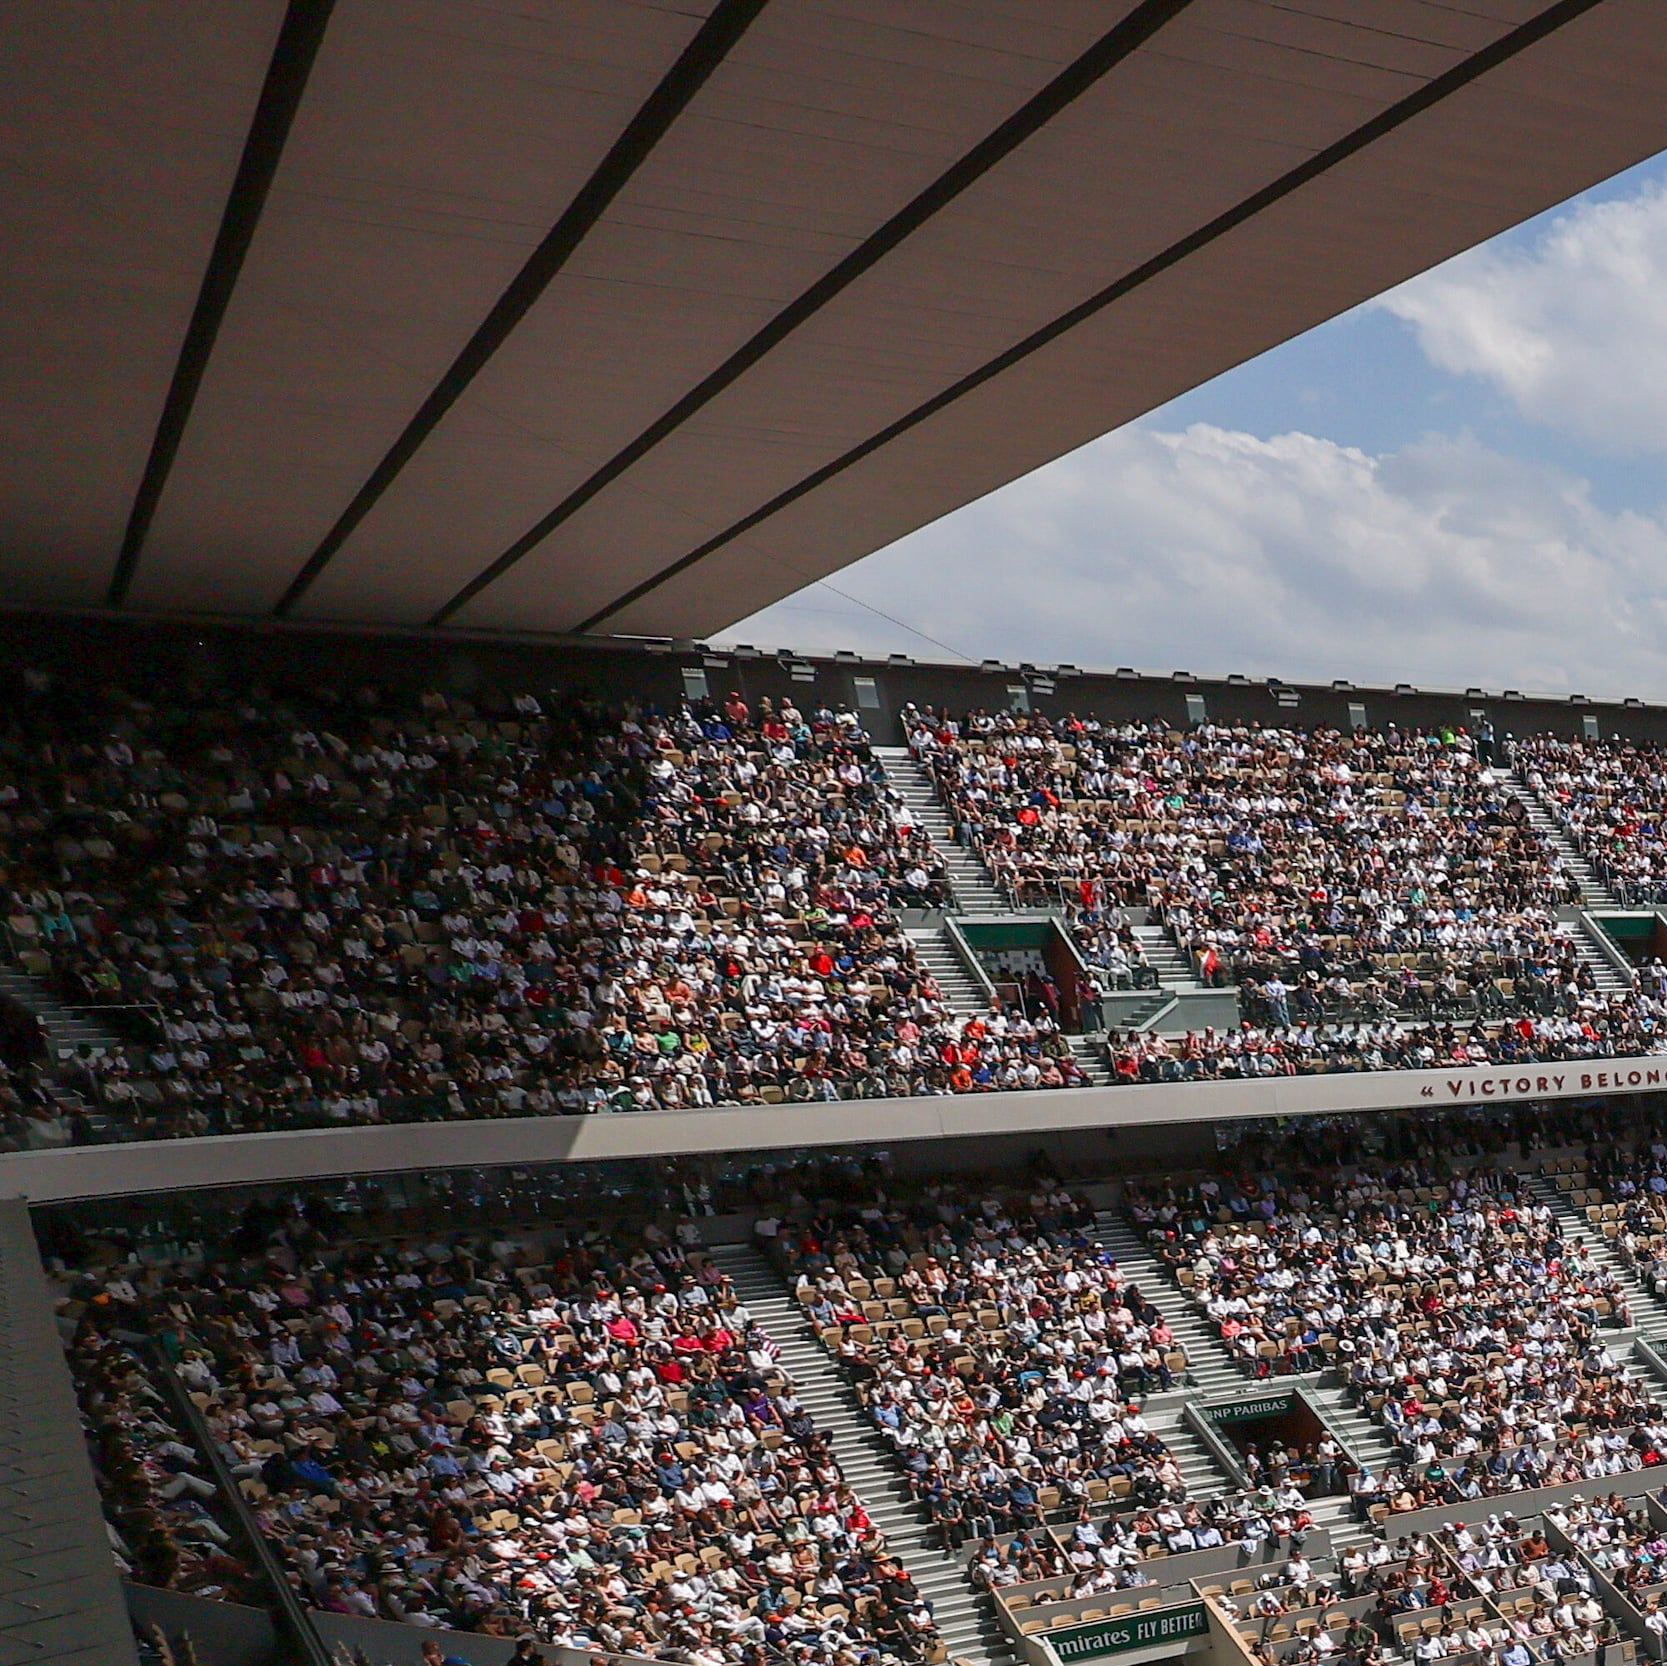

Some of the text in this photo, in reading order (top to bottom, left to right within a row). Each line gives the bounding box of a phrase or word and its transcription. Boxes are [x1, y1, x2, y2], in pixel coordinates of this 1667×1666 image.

[1447, 1074, 1566, 1097] VICTORY
[1234, 1400, 1287, 1416] PARIBAS
[1138, 1620, 1157, 1640] FLY
[1160, 1612, 1203, 1635] BETTER
